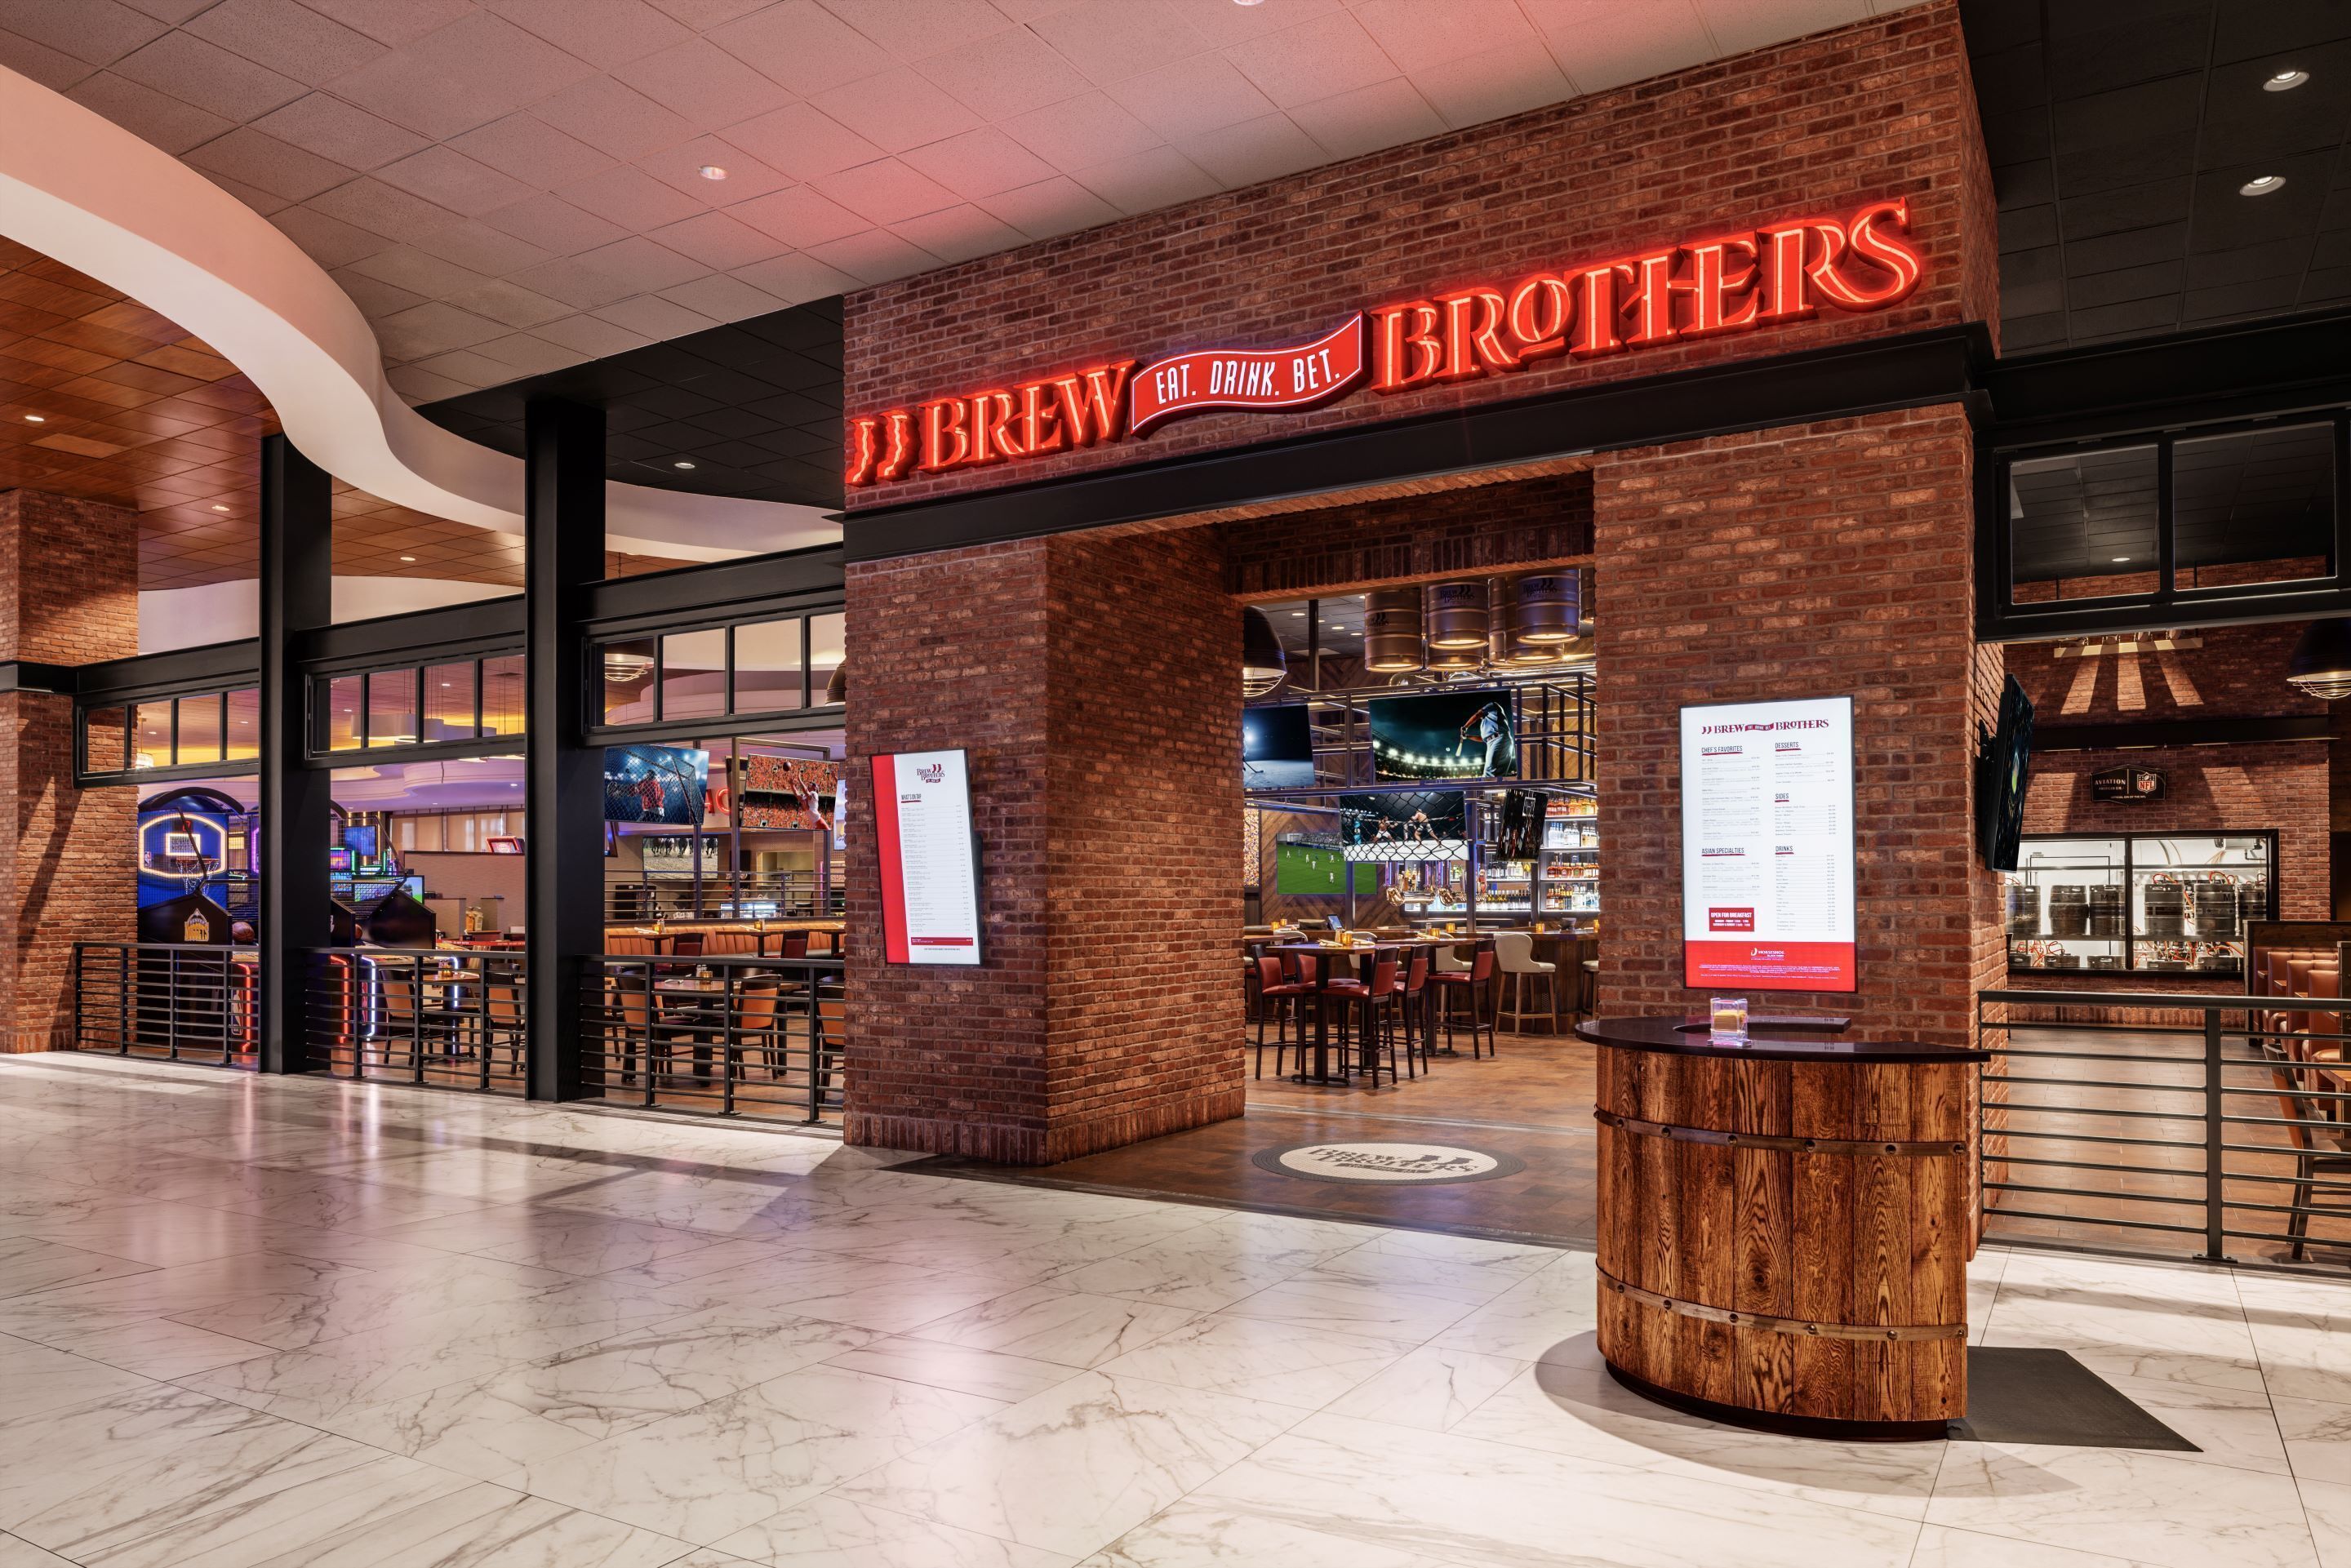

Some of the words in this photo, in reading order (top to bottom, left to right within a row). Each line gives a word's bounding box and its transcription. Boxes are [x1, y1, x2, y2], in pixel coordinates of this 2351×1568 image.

[918, 359, 1138, 473] BREW
[1371, 197, 1922, 395] BROTHERS
[1155, 363, 1197, 405] EAT.
[1209, 359, 1281, 396] DRINK.
[1293, 349, 1340, 393] BET.
[1714, 724, 1744, 734] BREW
[1775, 719, 1829, 731] BROTHERS
[2140, 780, 2154, 789] NFL
